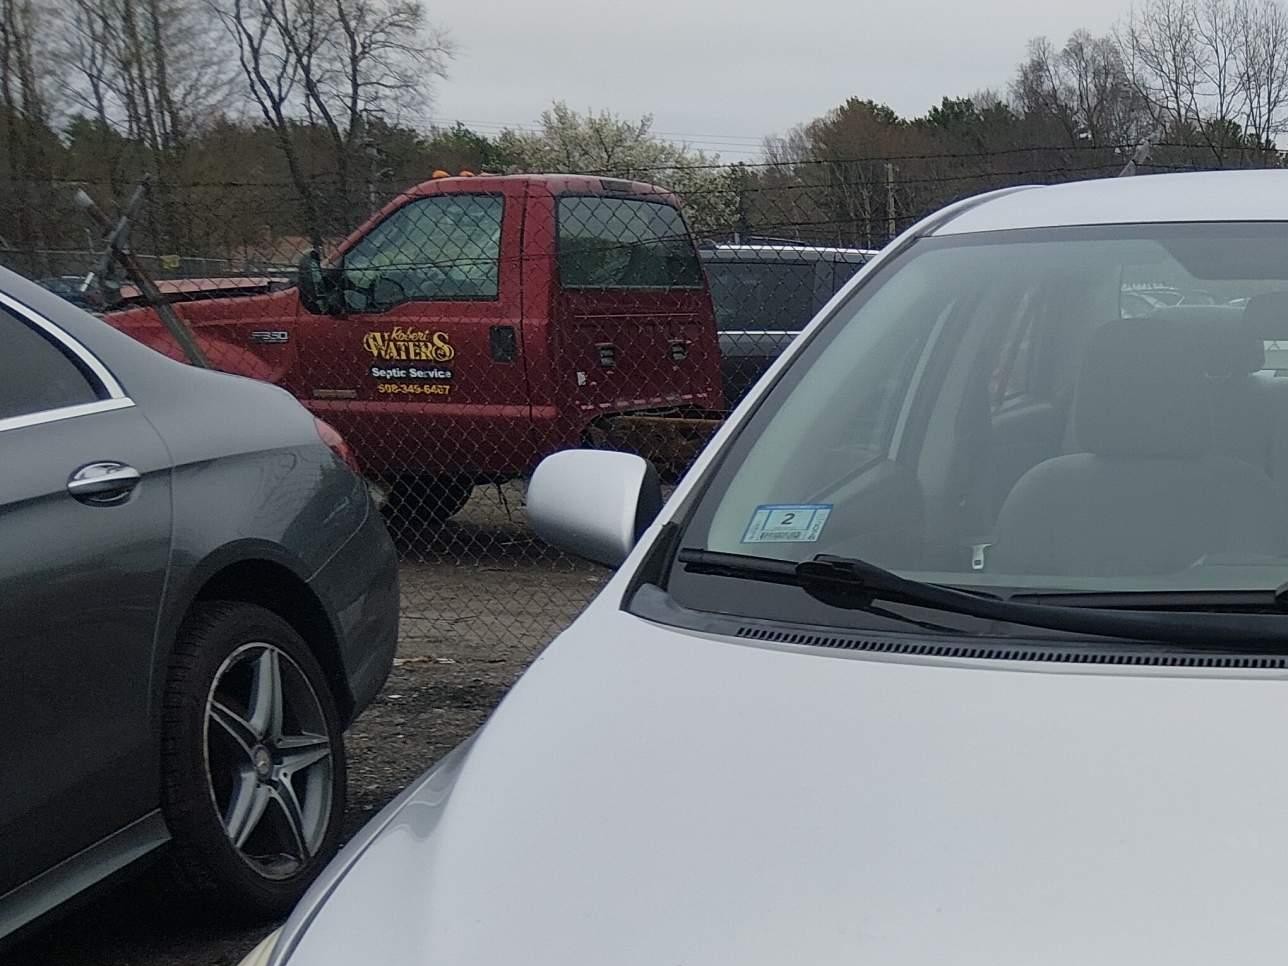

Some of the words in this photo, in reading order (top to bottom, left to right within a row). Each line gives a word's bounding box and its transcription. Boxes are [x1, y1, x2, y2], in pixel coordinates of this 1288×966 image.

[363, 332, 455, 361] WATERS
[371, 367, 408, 379] Septic
[409, 368, 452, 378] Service
[780, 513, 795, 525] 2
